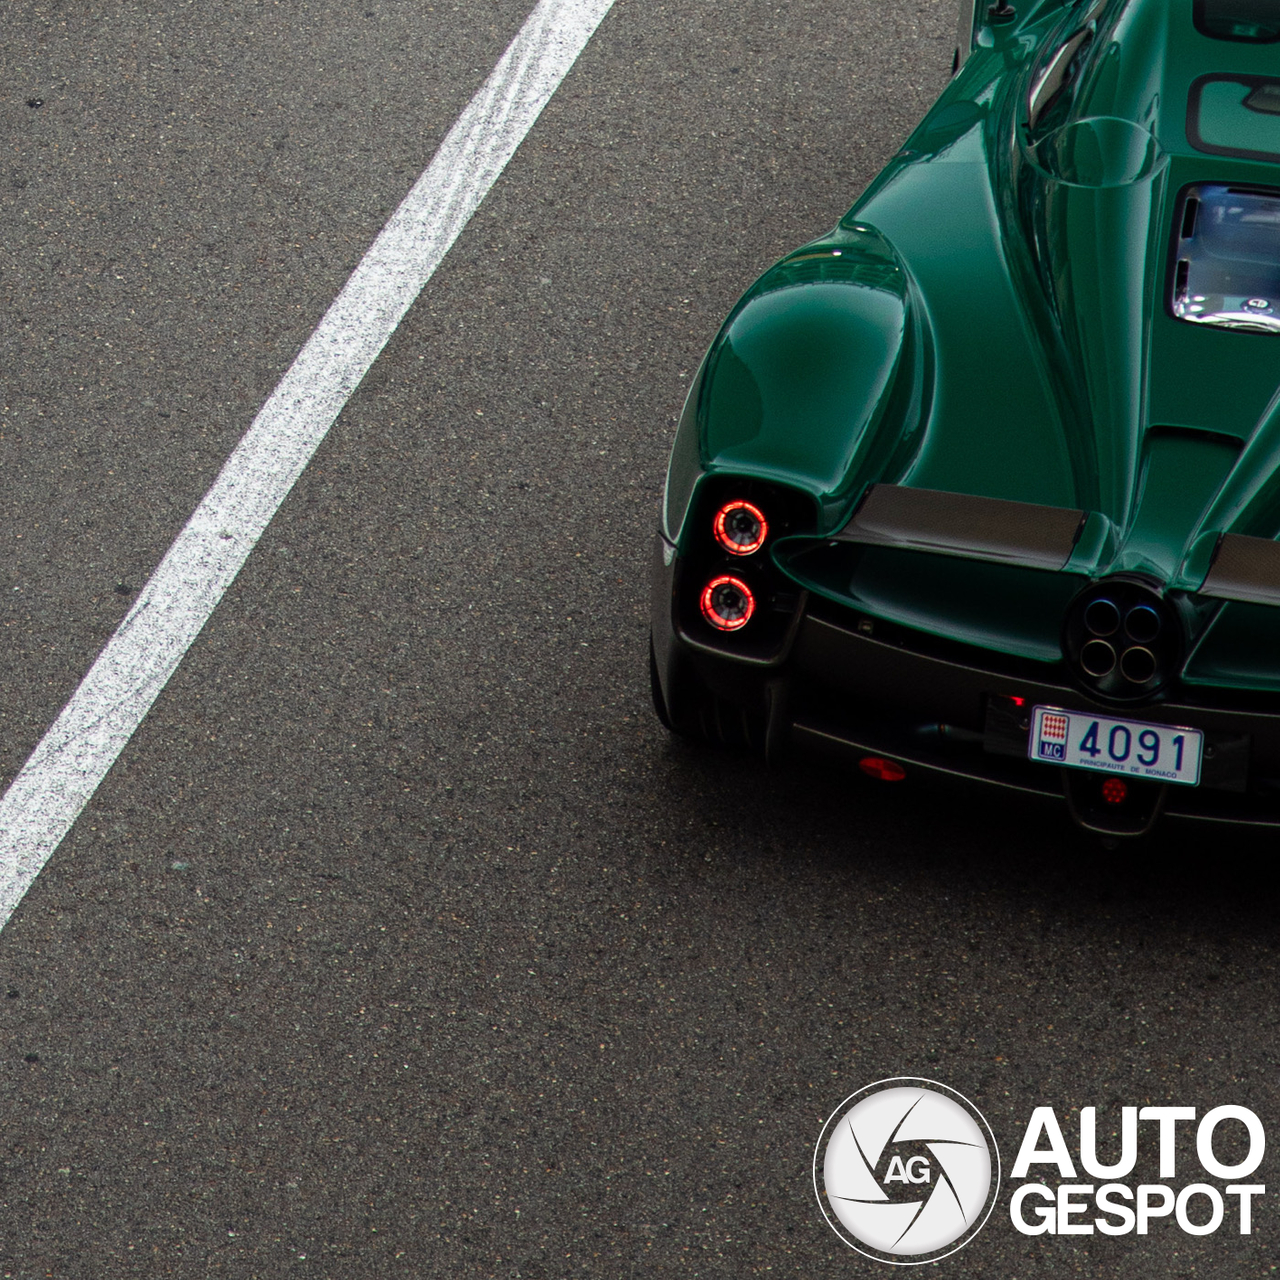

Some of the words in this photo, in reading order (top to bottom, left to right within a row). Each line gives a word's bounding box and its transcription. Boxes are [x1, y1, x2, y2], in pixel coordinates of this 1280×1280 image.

[1043, 743, 1062, 758] MC
[1079, 720, 1186, 772] 4091
[1145, 768, 1178, 779] MONACO
